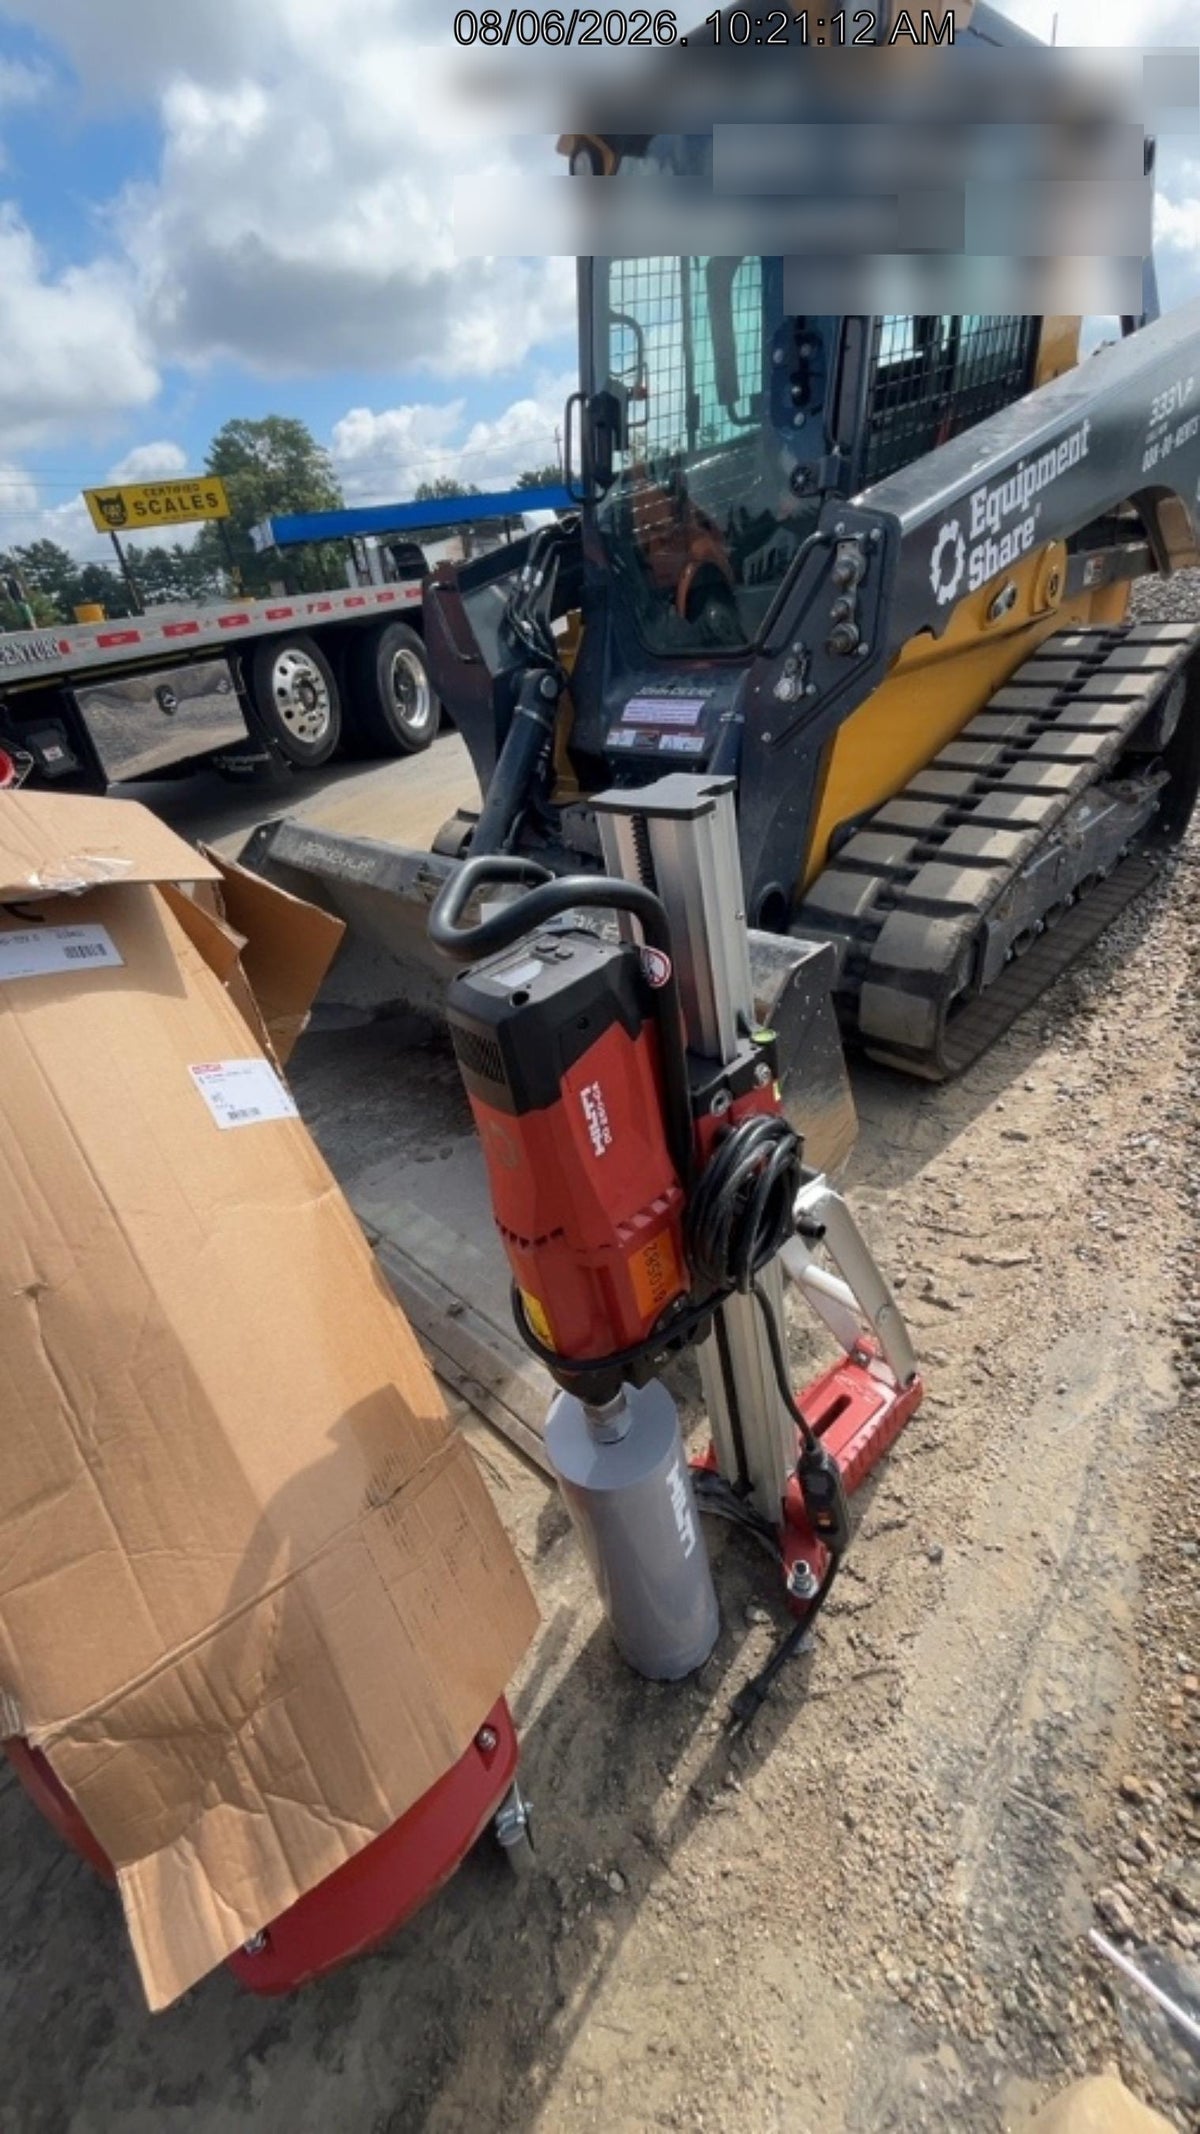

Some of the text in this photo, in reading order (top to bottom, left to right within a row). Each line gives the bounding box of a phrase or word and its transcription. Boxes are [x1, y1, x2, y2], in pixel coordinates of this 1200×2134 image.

[132, 492, 219, 516] SCALES
[969, 418, 1092, 540] Equipment
[968, 514, 1035, 592] Share
[580, 1087, 606, 1157] HILTI
[665, 1458, 696, 1561] HILTI
